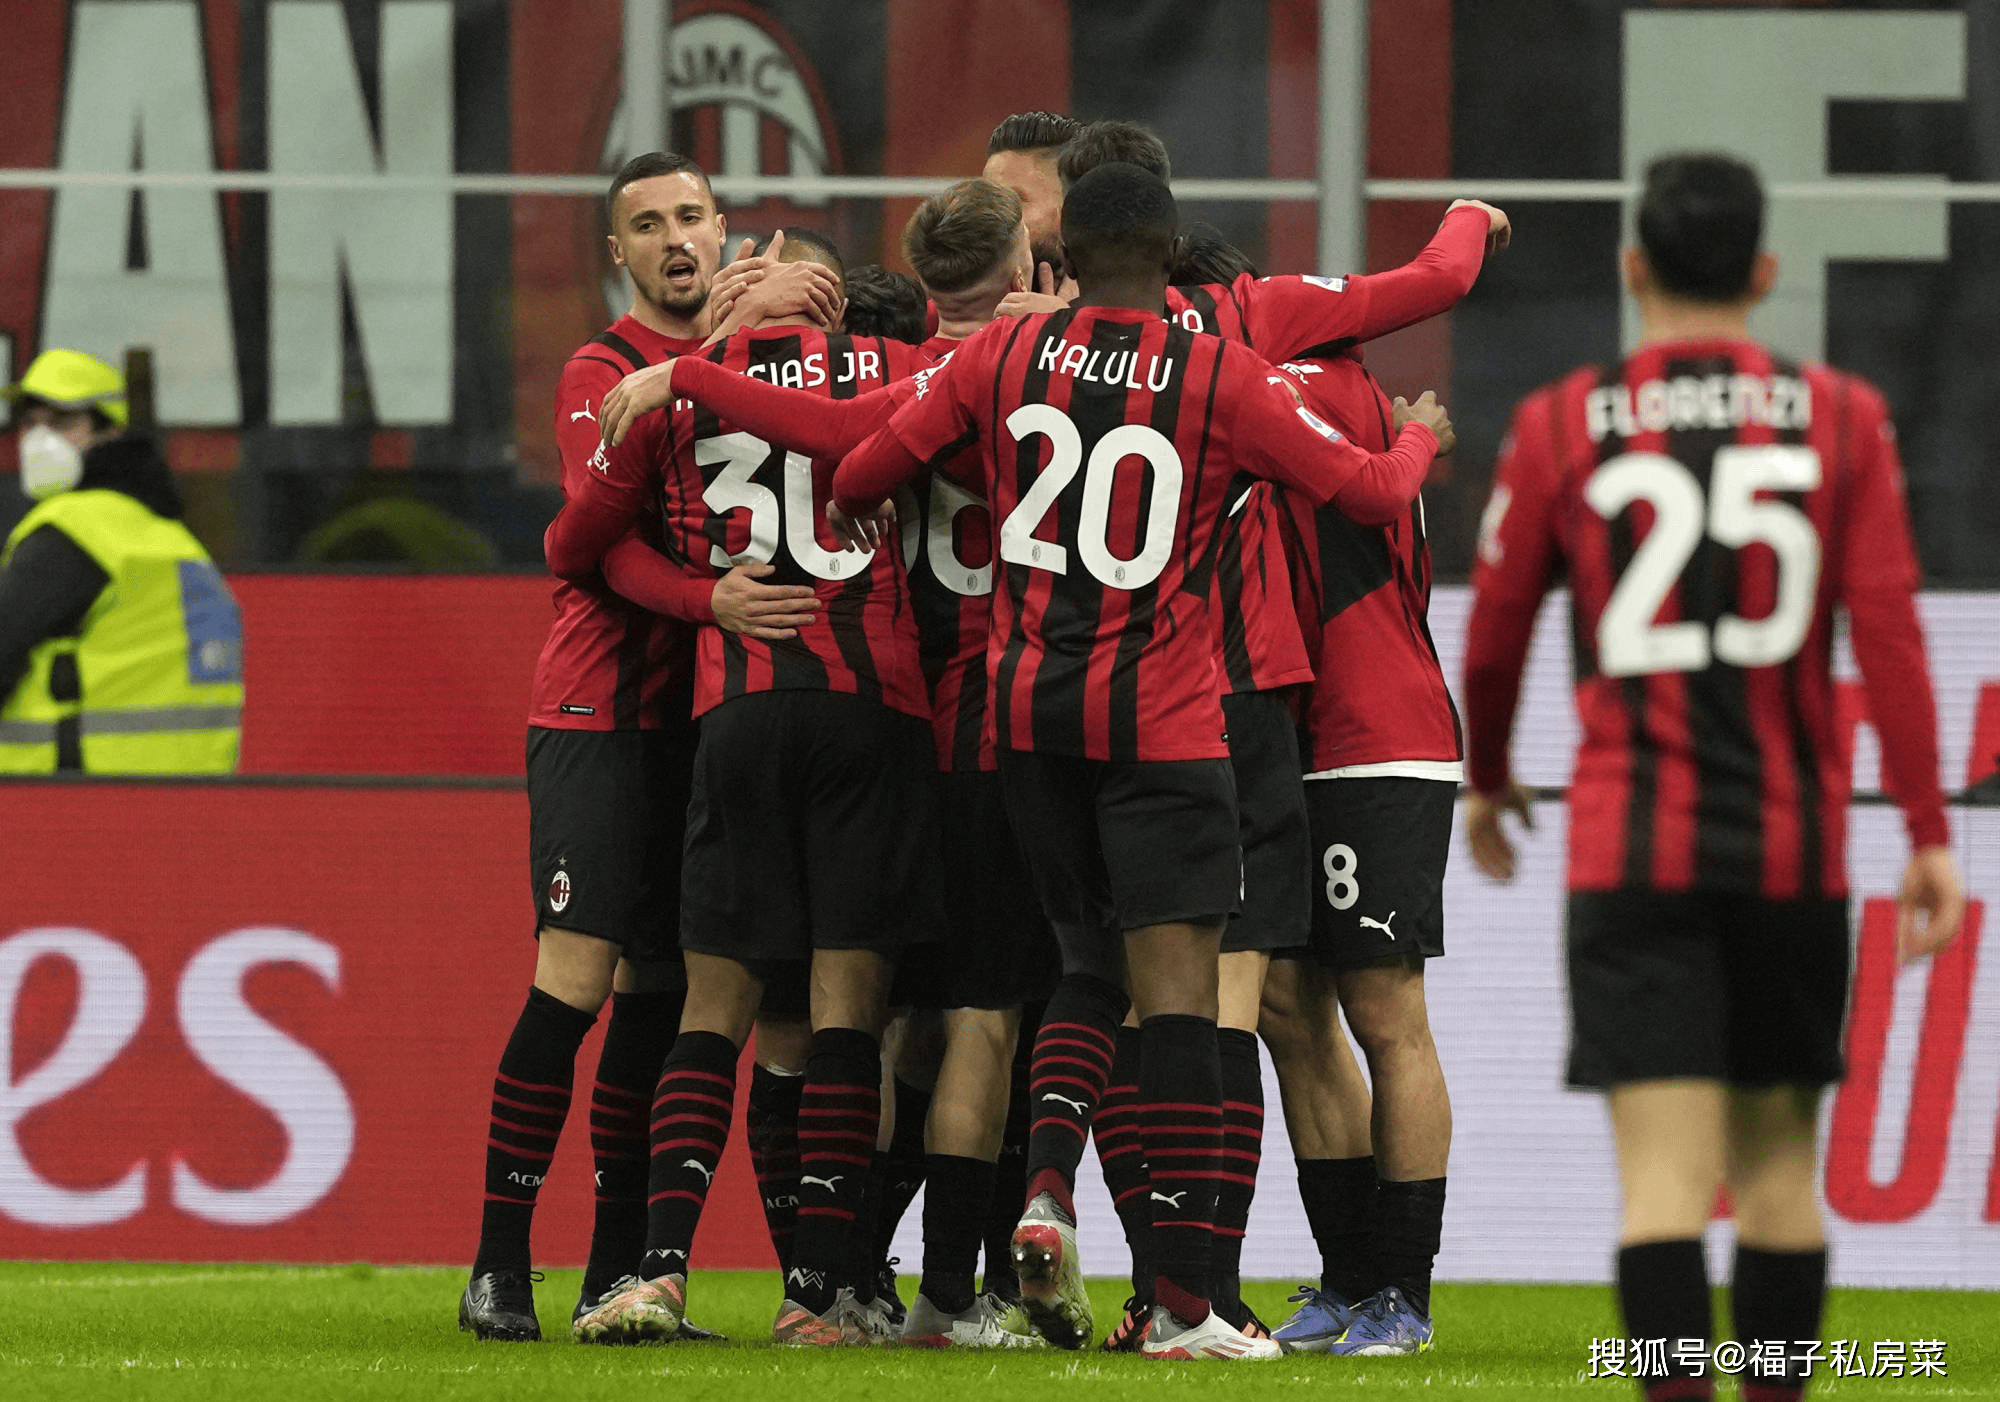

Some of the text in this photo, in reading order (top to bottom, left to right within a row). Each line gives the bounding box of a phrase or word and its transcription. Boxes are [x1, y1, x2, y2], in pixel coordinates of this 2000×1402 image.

[0, 0, 455, 427] AN
[837, 351, 880, 383] JR
[1037, 336, 1174, 393] KALULU
[1586, 375, 1812, 440] FLORENZI
[1000, 403, 1184, 590] 20
[1584, 445, 1822, 675] 25
[1323, 843, 1360, 911] 8
[507, 1171, 545, 1187] ACM
